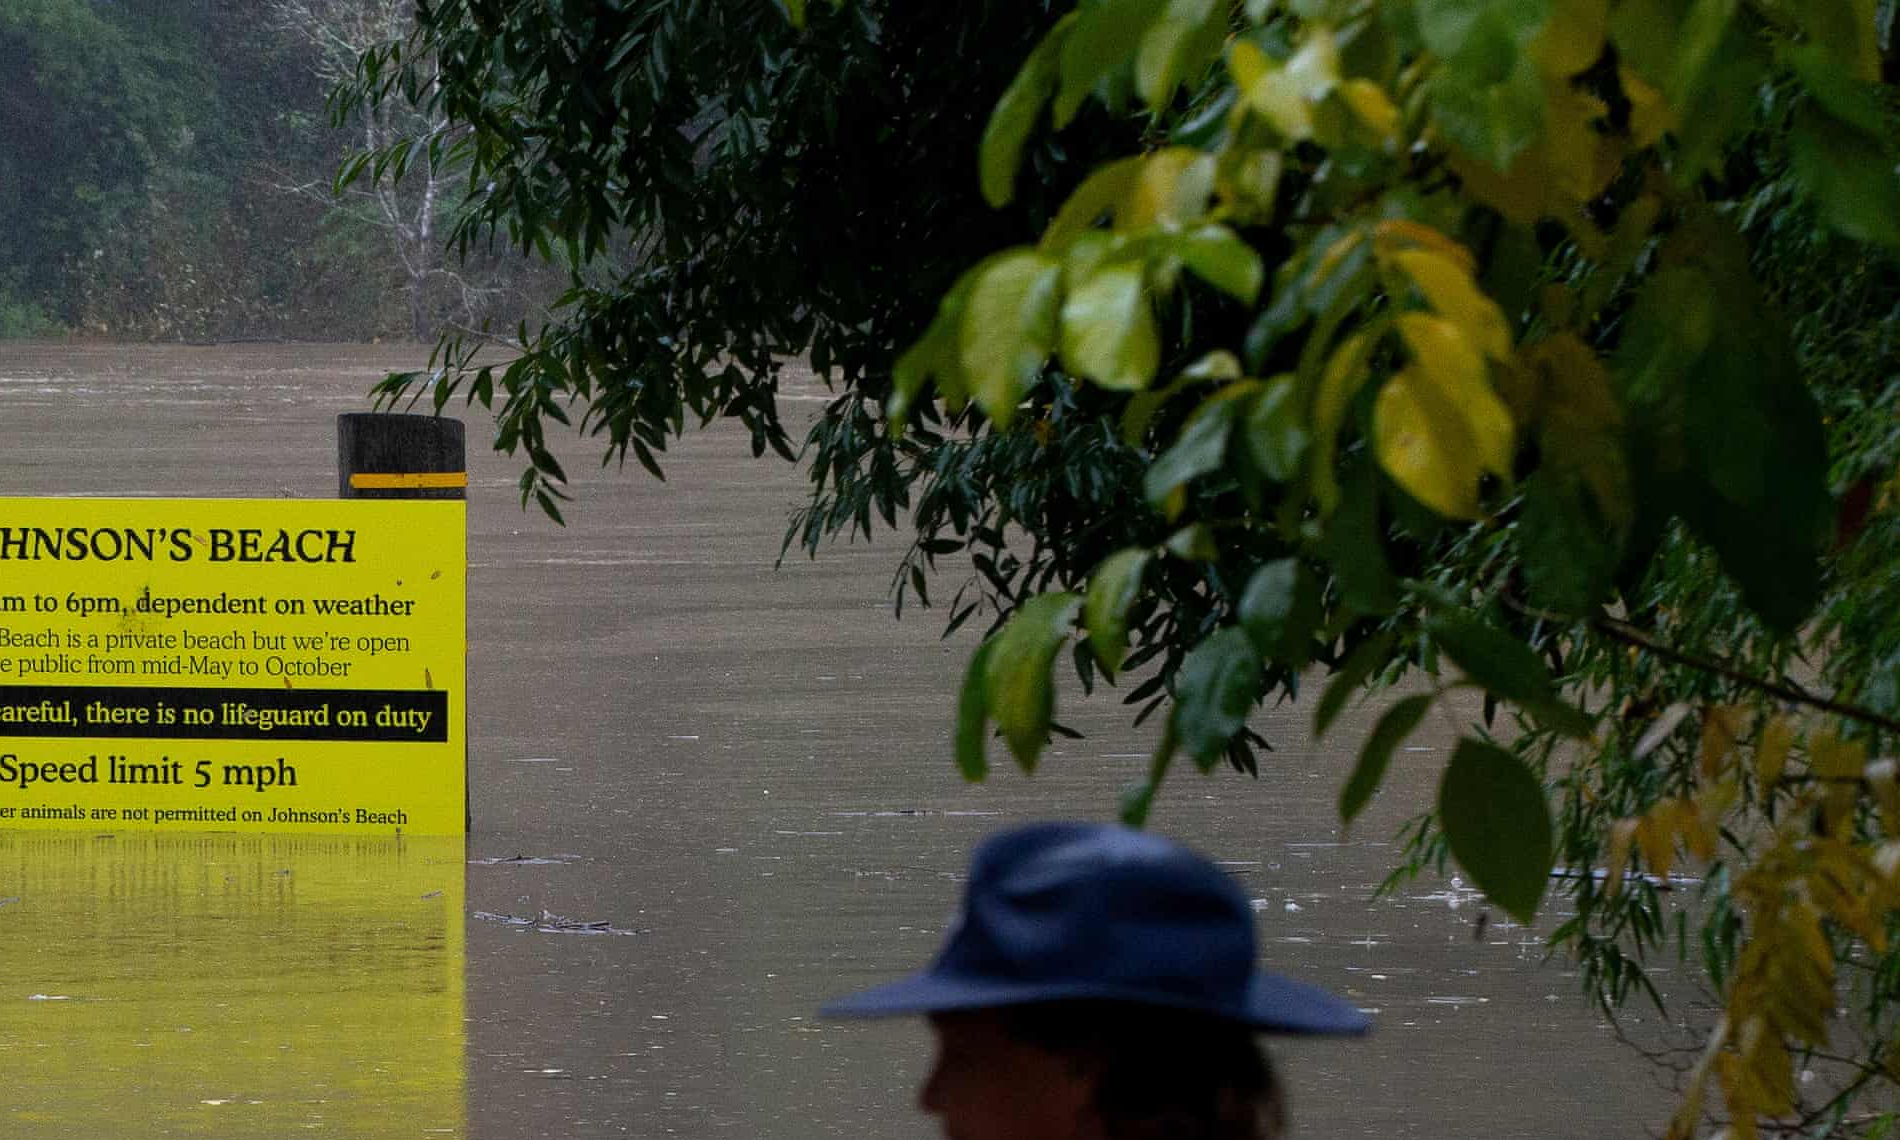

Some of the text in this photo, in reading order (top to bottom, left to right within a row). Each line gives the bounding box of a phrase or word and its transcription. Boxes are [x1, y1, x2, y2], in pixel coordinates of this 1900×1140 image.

[208, 528, 357, 563] BEACH
[34, 593, 58, 613] to
[65, 592, 128, 618] 6pm,
[135, 591, 267, 618] dependent
[274, 599, 305, 615] on
[313, 594, 415, 616] weather
[66, 629, 81, 648] is
[87, 635, 99, 648] a
[106, 630, 177, 653] private
[183, 631, 246, 651] beach
[253, 631, 287, 651] but
[292, 632, 350, 652] we're
[357, 637, 410, 656] open
[18, 655, 82, 677] public
[88, 655, 136, 674] from
[142, 656, 233, 681] mid-May
[238, 660, 259, 676] to
[265, 656, 352, 677] October
[86, 702, 149, 724] there
[157, 703, 176, 724] is
[183, 708, 214, 725] no
[221, 703, 330, 730] lifeguard
[336, 710, 368, 727] on
[375, 704, 432, 733] duty
[108, 756, 184, 785] limit
[194, 760, 213, 788] 5
[223, 758, 298, 792] mph
[21, 803, 86, 820] animals
[91, 808, 117, 820] are
[122, 806, 148, 821] not
[154, 806, 237, 825] permitted
[242, 810, 263, 823] on
[267, 807, 351, 825] Johnson's
[355, 809, 408, 825] Beach
